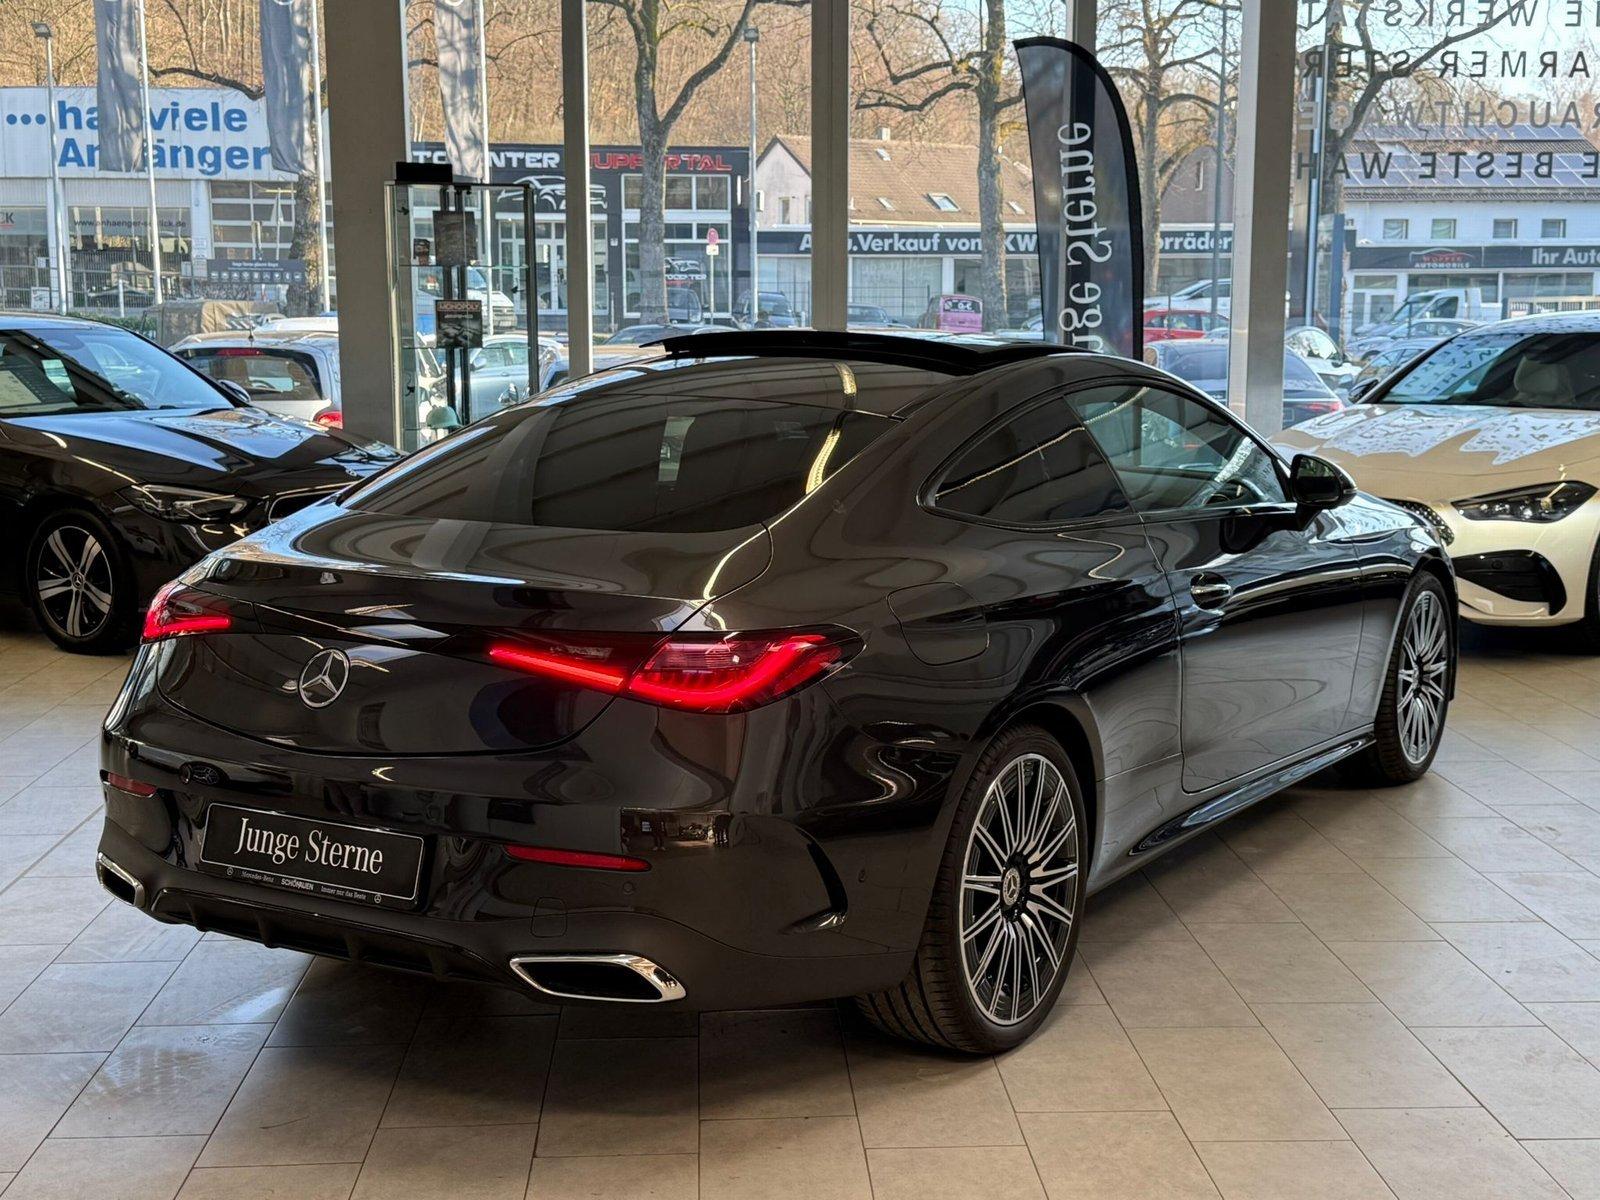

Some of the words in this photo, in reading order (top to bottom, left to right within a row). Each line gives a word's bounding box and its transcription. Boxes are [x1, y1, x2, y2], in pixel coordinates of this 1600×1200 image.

[57, 100, 98, 130] ha
[149, 101, 247, 132] viele
[58, 138, 270, 176] Anänger
[944, 238, 982, 252] von
[1003, 233, 1038, 252] KW
[1531, 247, 1560, 265] Ihr
[233, 817, 300, 865] Junge
[304, 829, 384, 875] Sterne
